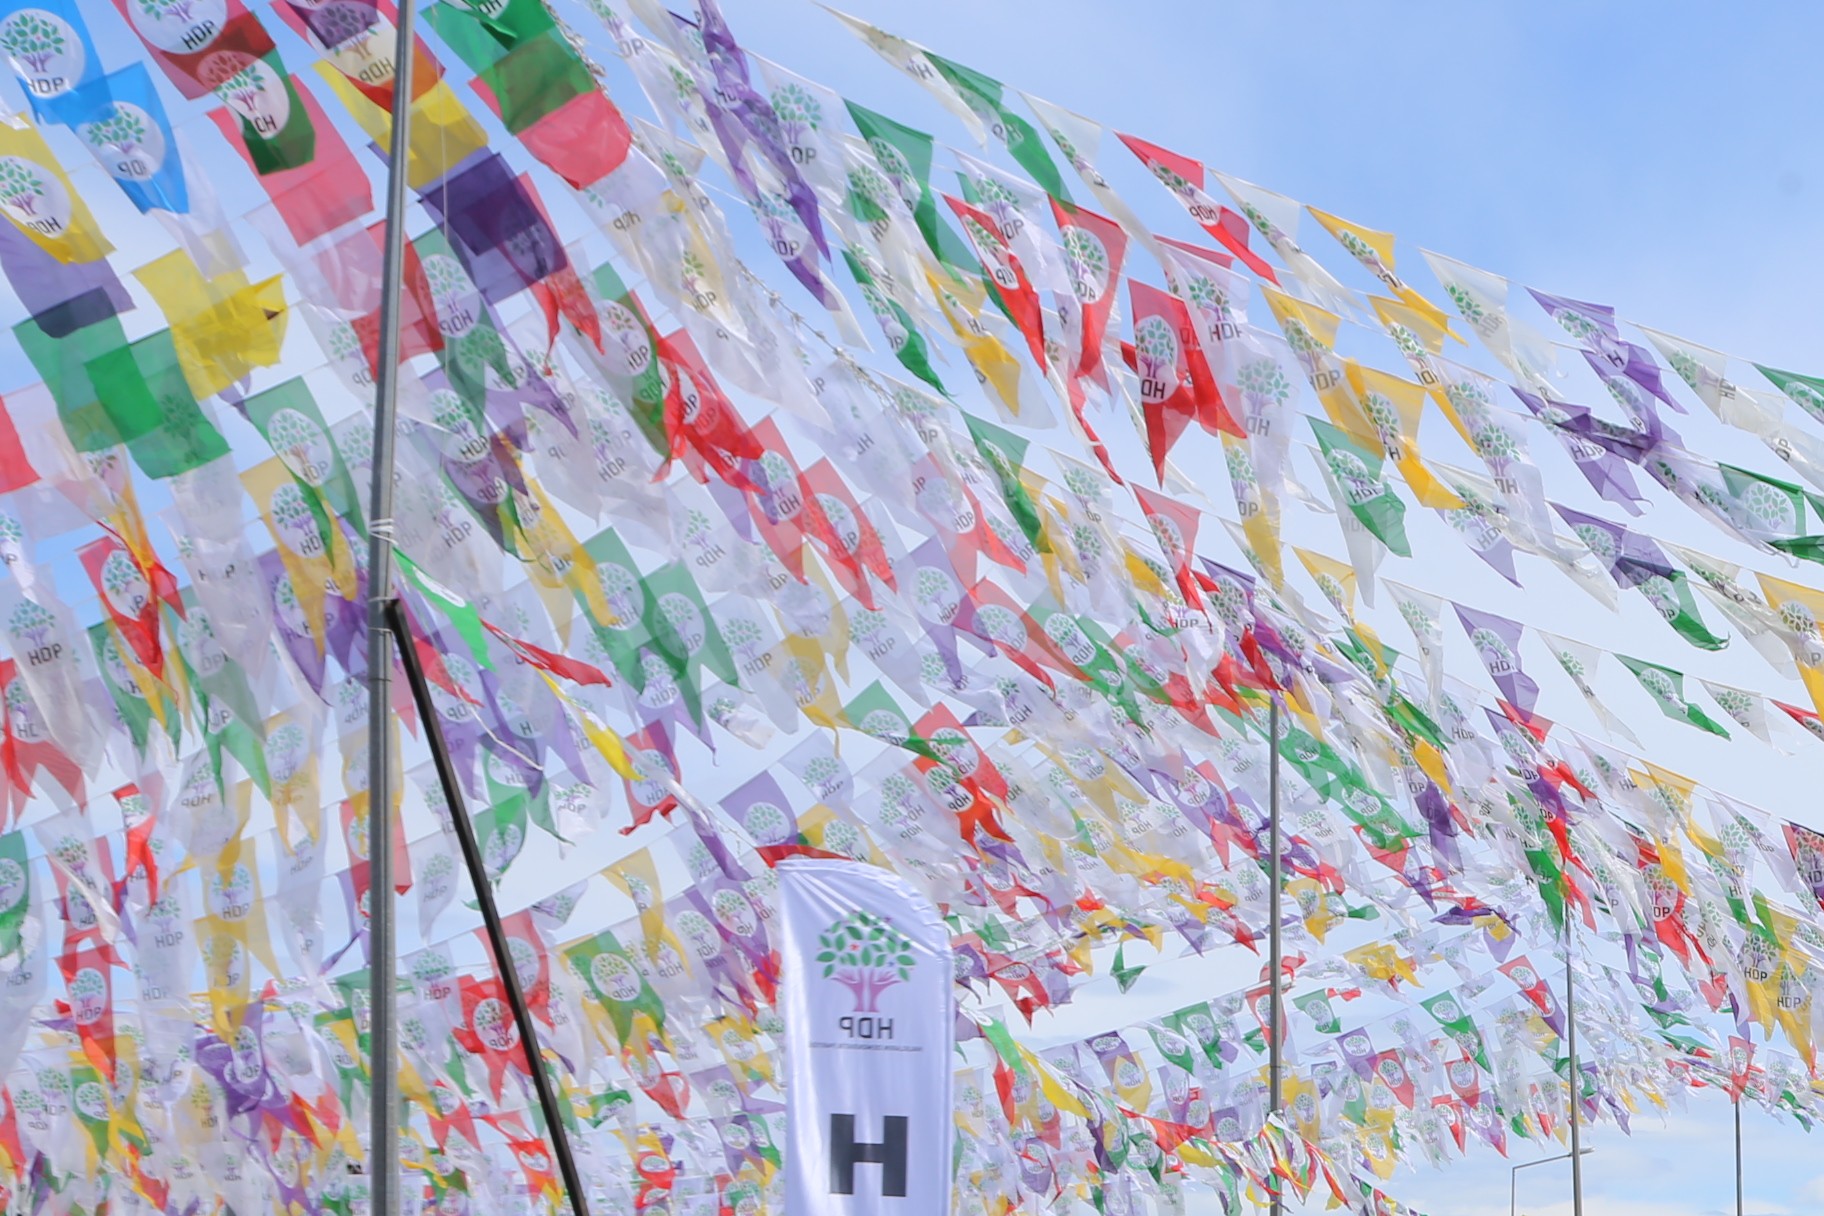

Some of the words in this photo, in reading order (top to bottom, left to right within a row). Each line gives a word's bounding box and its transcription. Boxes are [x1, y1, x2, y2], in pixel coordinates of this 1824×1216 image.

[181, 19, 216, 50] HDP
[459, 436, 491, 458] HDP
[600, 457, 626, 482] HDP
[1237, 502, 1259, 517] DP
[951, 513, 975, 534] HDP
[442, 522, 472, 548] HDP
[938, 603, 959, 625] HDP
[27, 643, 64, 667] HDP
[869, 637, 896, 661] HDP
[743, 652, 773, 675] HDP
[651, 684, 678, 705] HDP
[154, 932, 184, 949] HDP
[1744, 968, 1769, 982] HDP
[1776, 996, 1801, 1009] HDP
